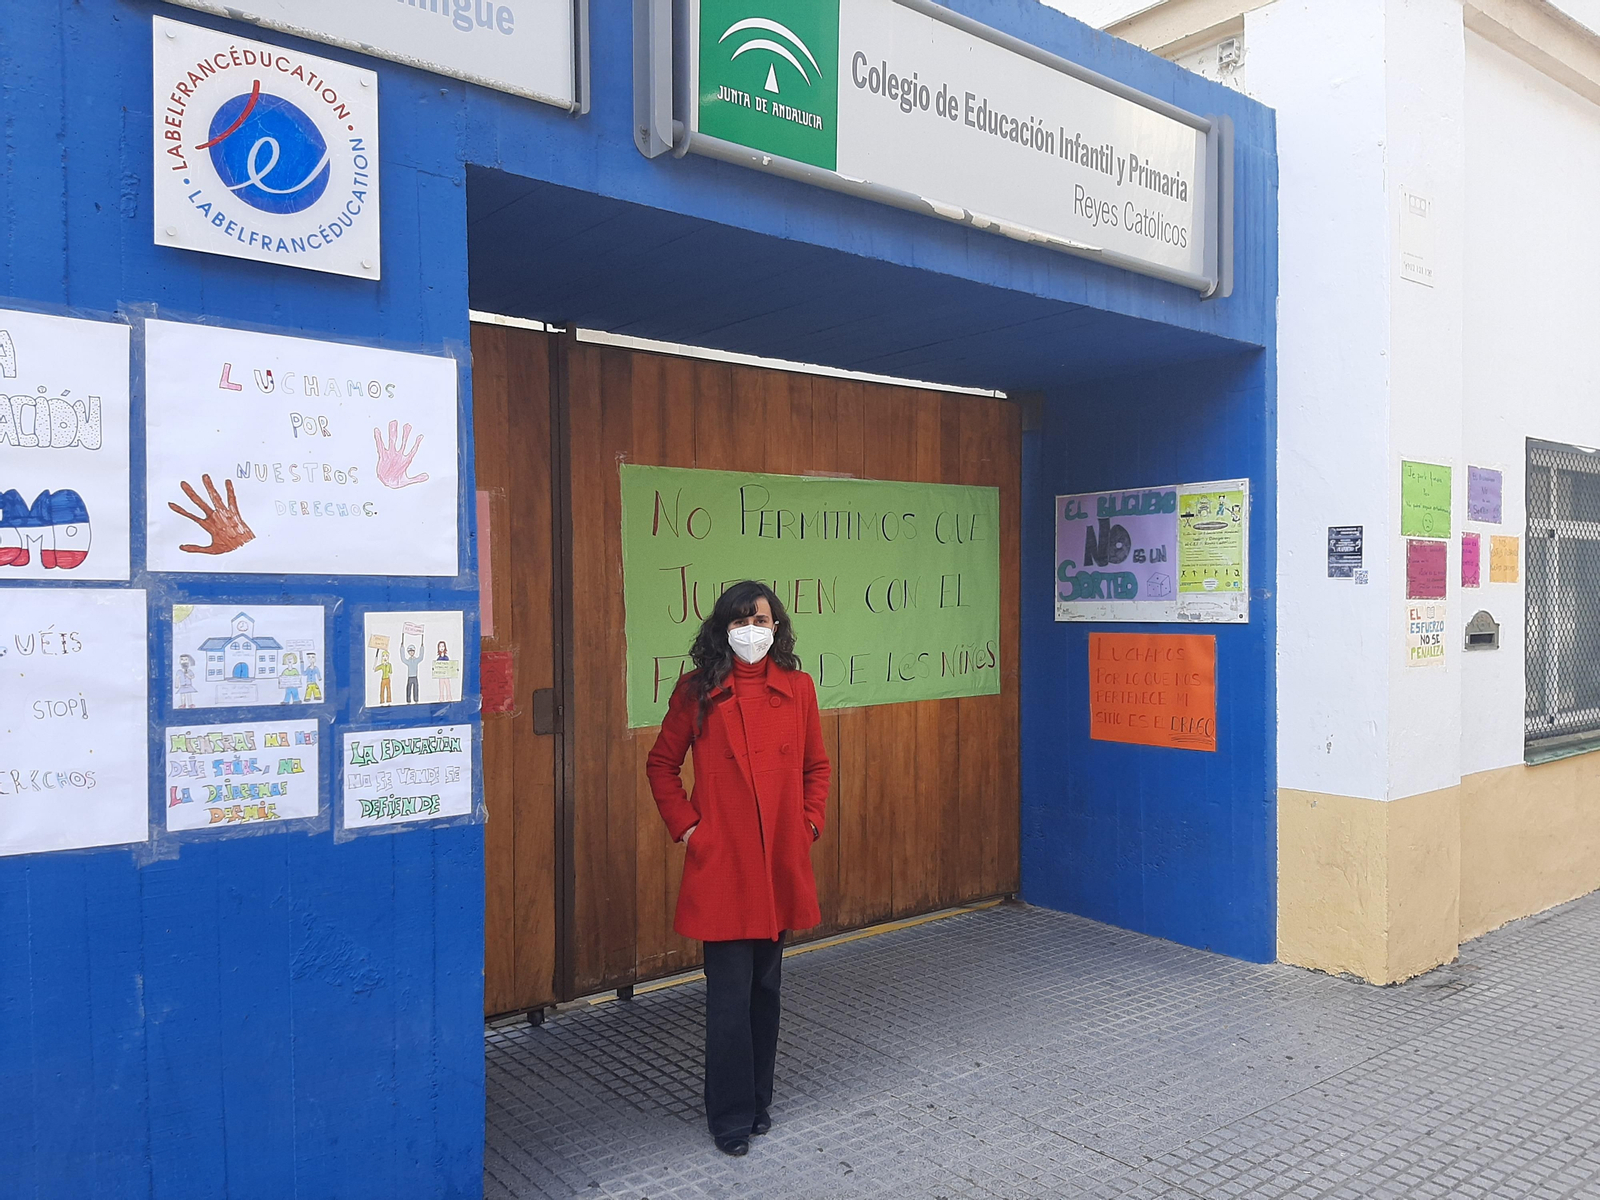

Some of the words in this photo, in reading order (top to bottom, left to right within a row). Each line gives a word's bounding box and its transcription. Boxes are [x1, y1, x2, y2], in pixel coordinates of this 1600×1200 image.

[165, 45, 350, 171] LABELFRANCÉDUCATION
[717, 85, 750, 108] JUNTA
[755, 96, 768, 113] DE
[772, 101, 823, 131] ANDALUCIA
[851, 50, 930, 114] Colegio
[935, 83, 959, 122] de
[963, 91, 1056, 156] Educación
[1059, 126, 1114, 177] Infantil
[1116, 155, 1126, 186] y
[1129, 153, 1188, 202] Primaria
[188, 137, 369, 254] LABELFRANCÉDUCATION
[1073, 184, 1118, 230] Reyes
[1123, 201, 1188, 249] Católicos
[219, 362, 396, 399] LUCHAMOS
[289, 412, 331, 439] POR
[236, 461, 359, 485] NUESTROS
[275, 500, 378, 517] DERECHOS.
[652, 487, 712, 540] NO
[739, 483, 918, 542] PERMITIMOS
[935, 512, 987, 545] QUE
[1064, 499, 1088, 521] EL
[1083, 518, 1132, 567] NO
[1133, 548, 1146, 564] ES
[1149, 544, 1168, 564] UN
[1057, 559, 1139, 601] SORTEO
[865, 575, 921, 614] CON
[940, 573, 971, 608] EL
[1409, 608, 1421, 621] EL
[1410, 620, 1444, 634] ESFUERZO
[1096, 637, 1185, 662] LUCHAMOS
[1410, 645, 1445, 660] PENALIZA
[1420, 634, 1430, 646] NO
[1431, 634, 1441, 646] SE
[819, 652, 871, 688] DE
[1095, 667, 1120, 685] POR
[1125, 672, 1139, 685] LO
[1144, 672, 1170, 686] QUE
[32, 698, 89, 720] STOP!
[1096, 690, 1167, 705] PERTENECE
[1129, 714, 1149, 729] ES
[1170, 716, 1215, 738] DRAGO
[277, 758, 305, 775] NO
[350, 741, 379, 767] LA
